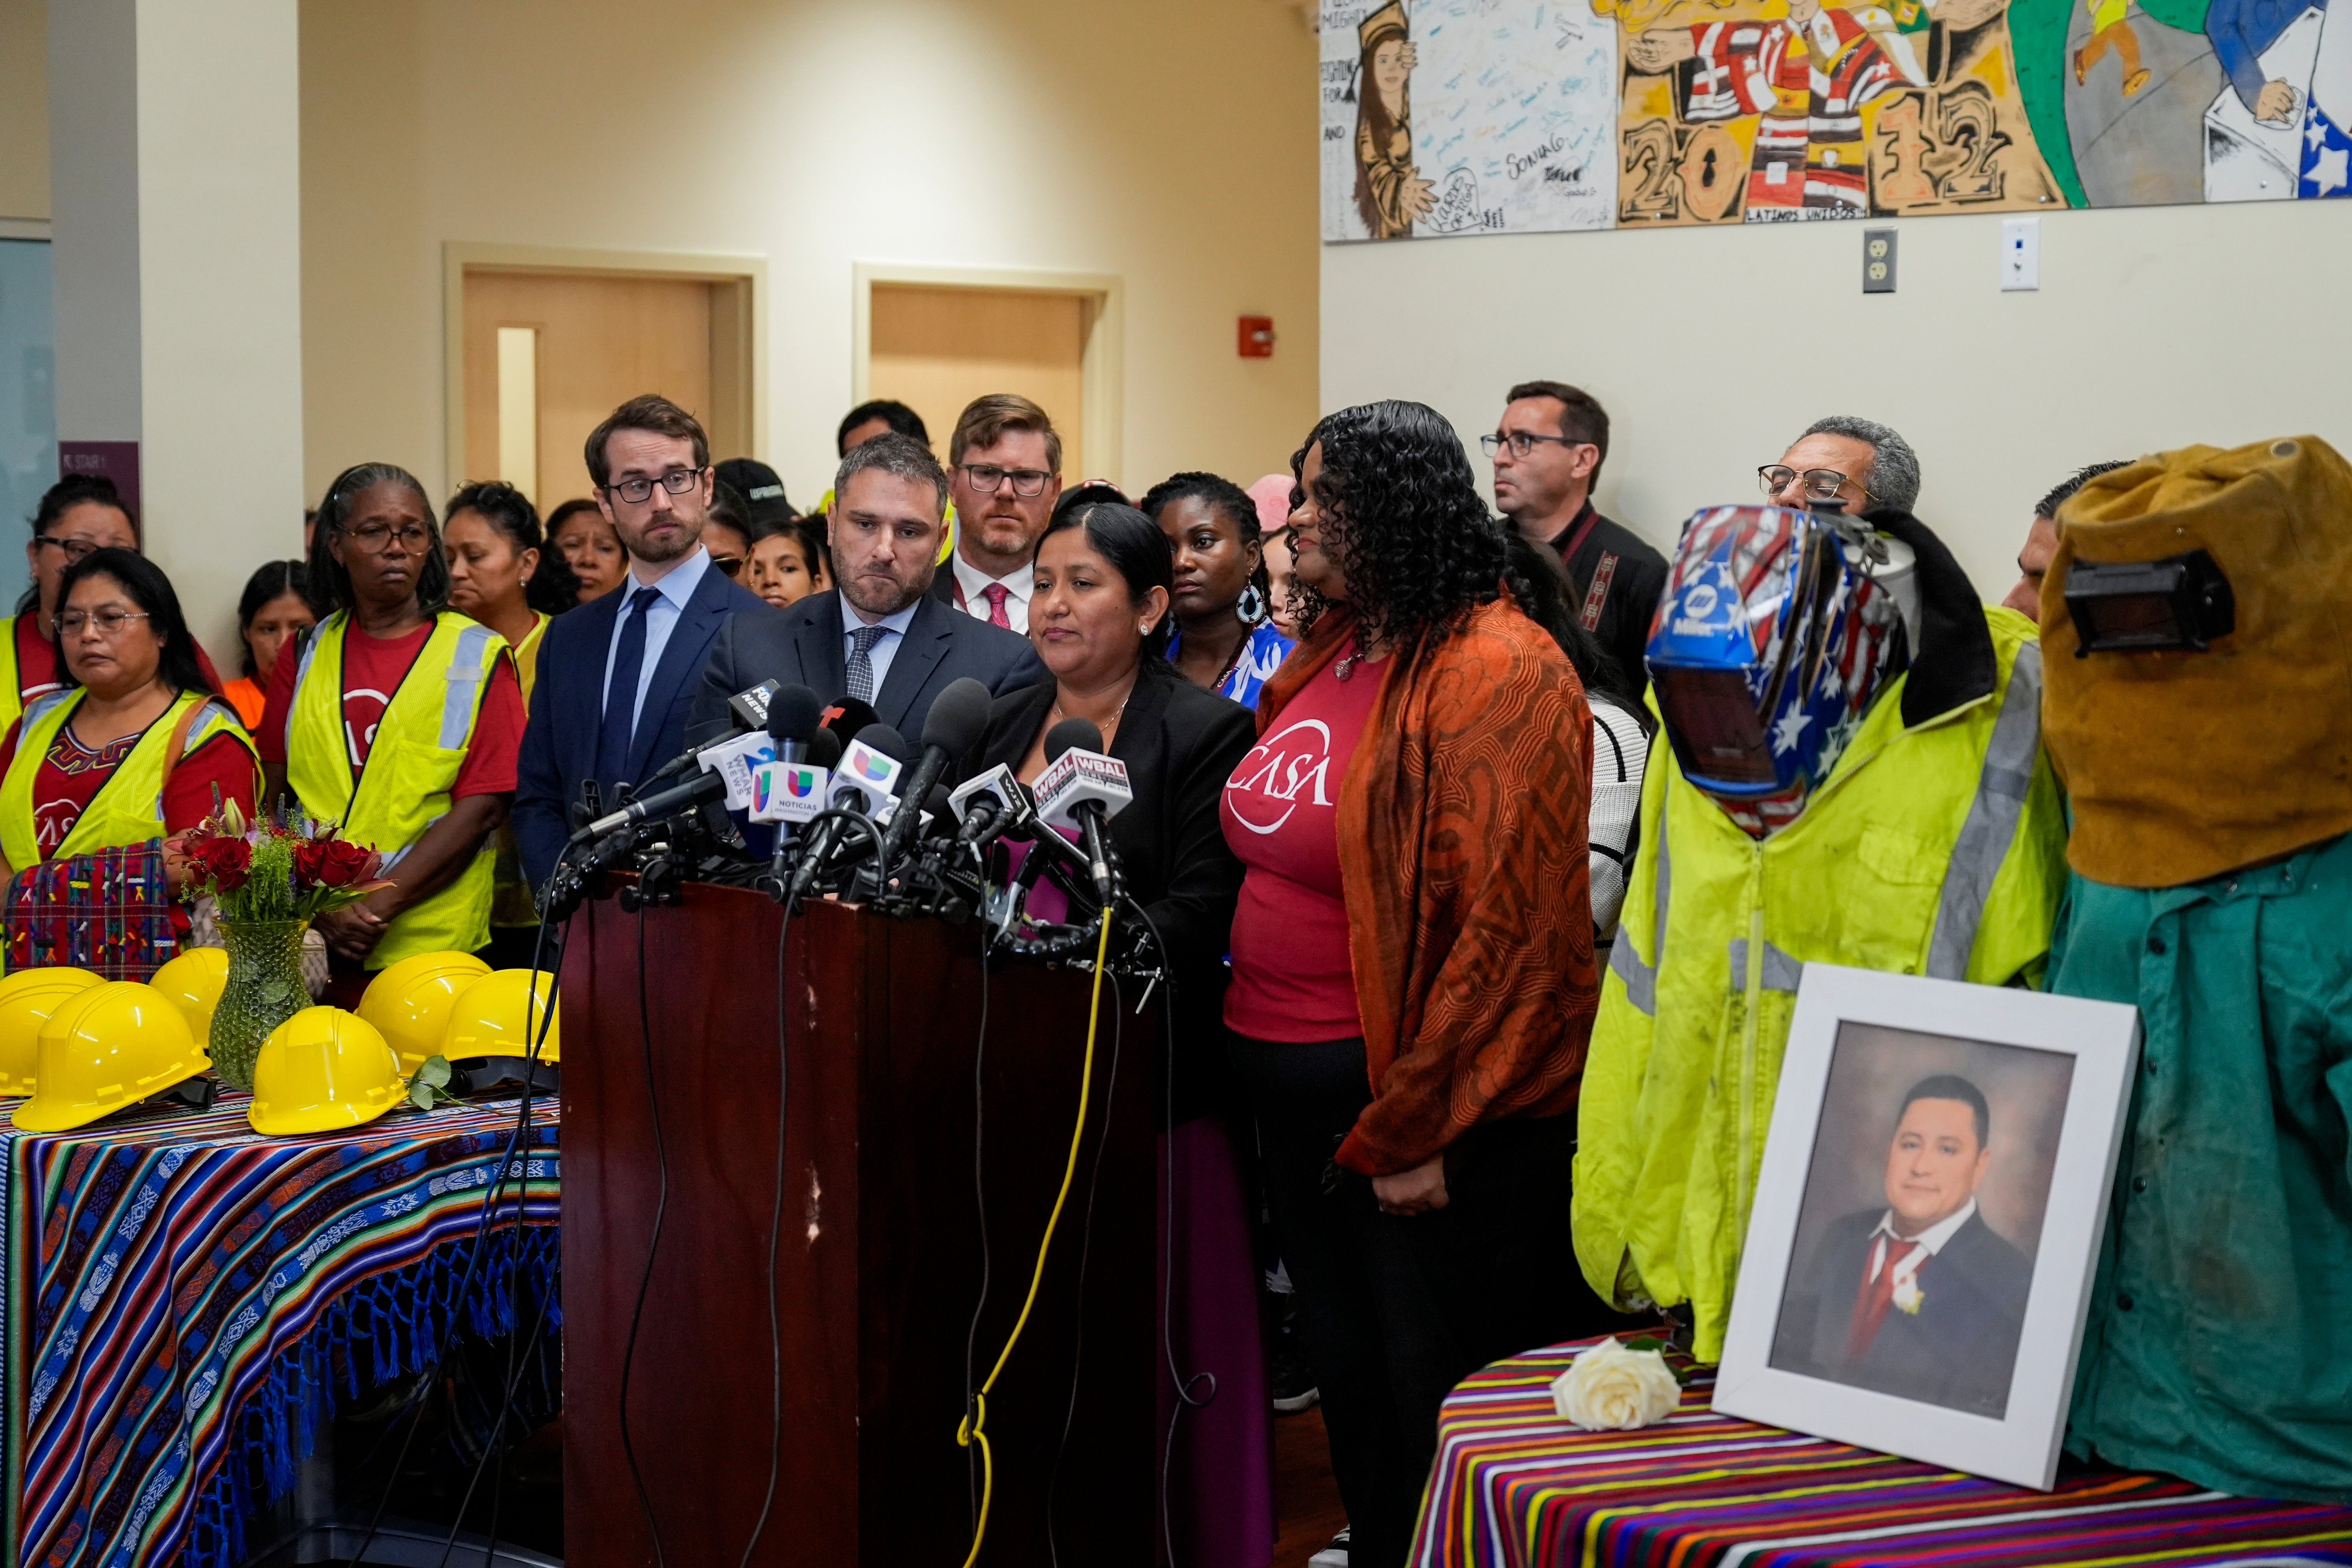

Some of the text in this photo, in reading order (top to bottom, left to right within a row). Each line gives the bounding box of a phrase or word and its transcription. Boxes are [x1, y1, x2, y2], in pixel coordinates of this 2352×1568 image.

[1324, 125, 1345, 140] AND
[1217, 670, 1233, 688] CASA
[1077, 757, 1125, 778] WBAL
[1226, 745, 1334, 806] CASA
[727, 762, 744, 795] NEWS
[1035, 759, 1074, 798] WBAL
[774, 808, 809, 816] WASHINGTON
[779, 800, 817, 811] NOTICIAS
